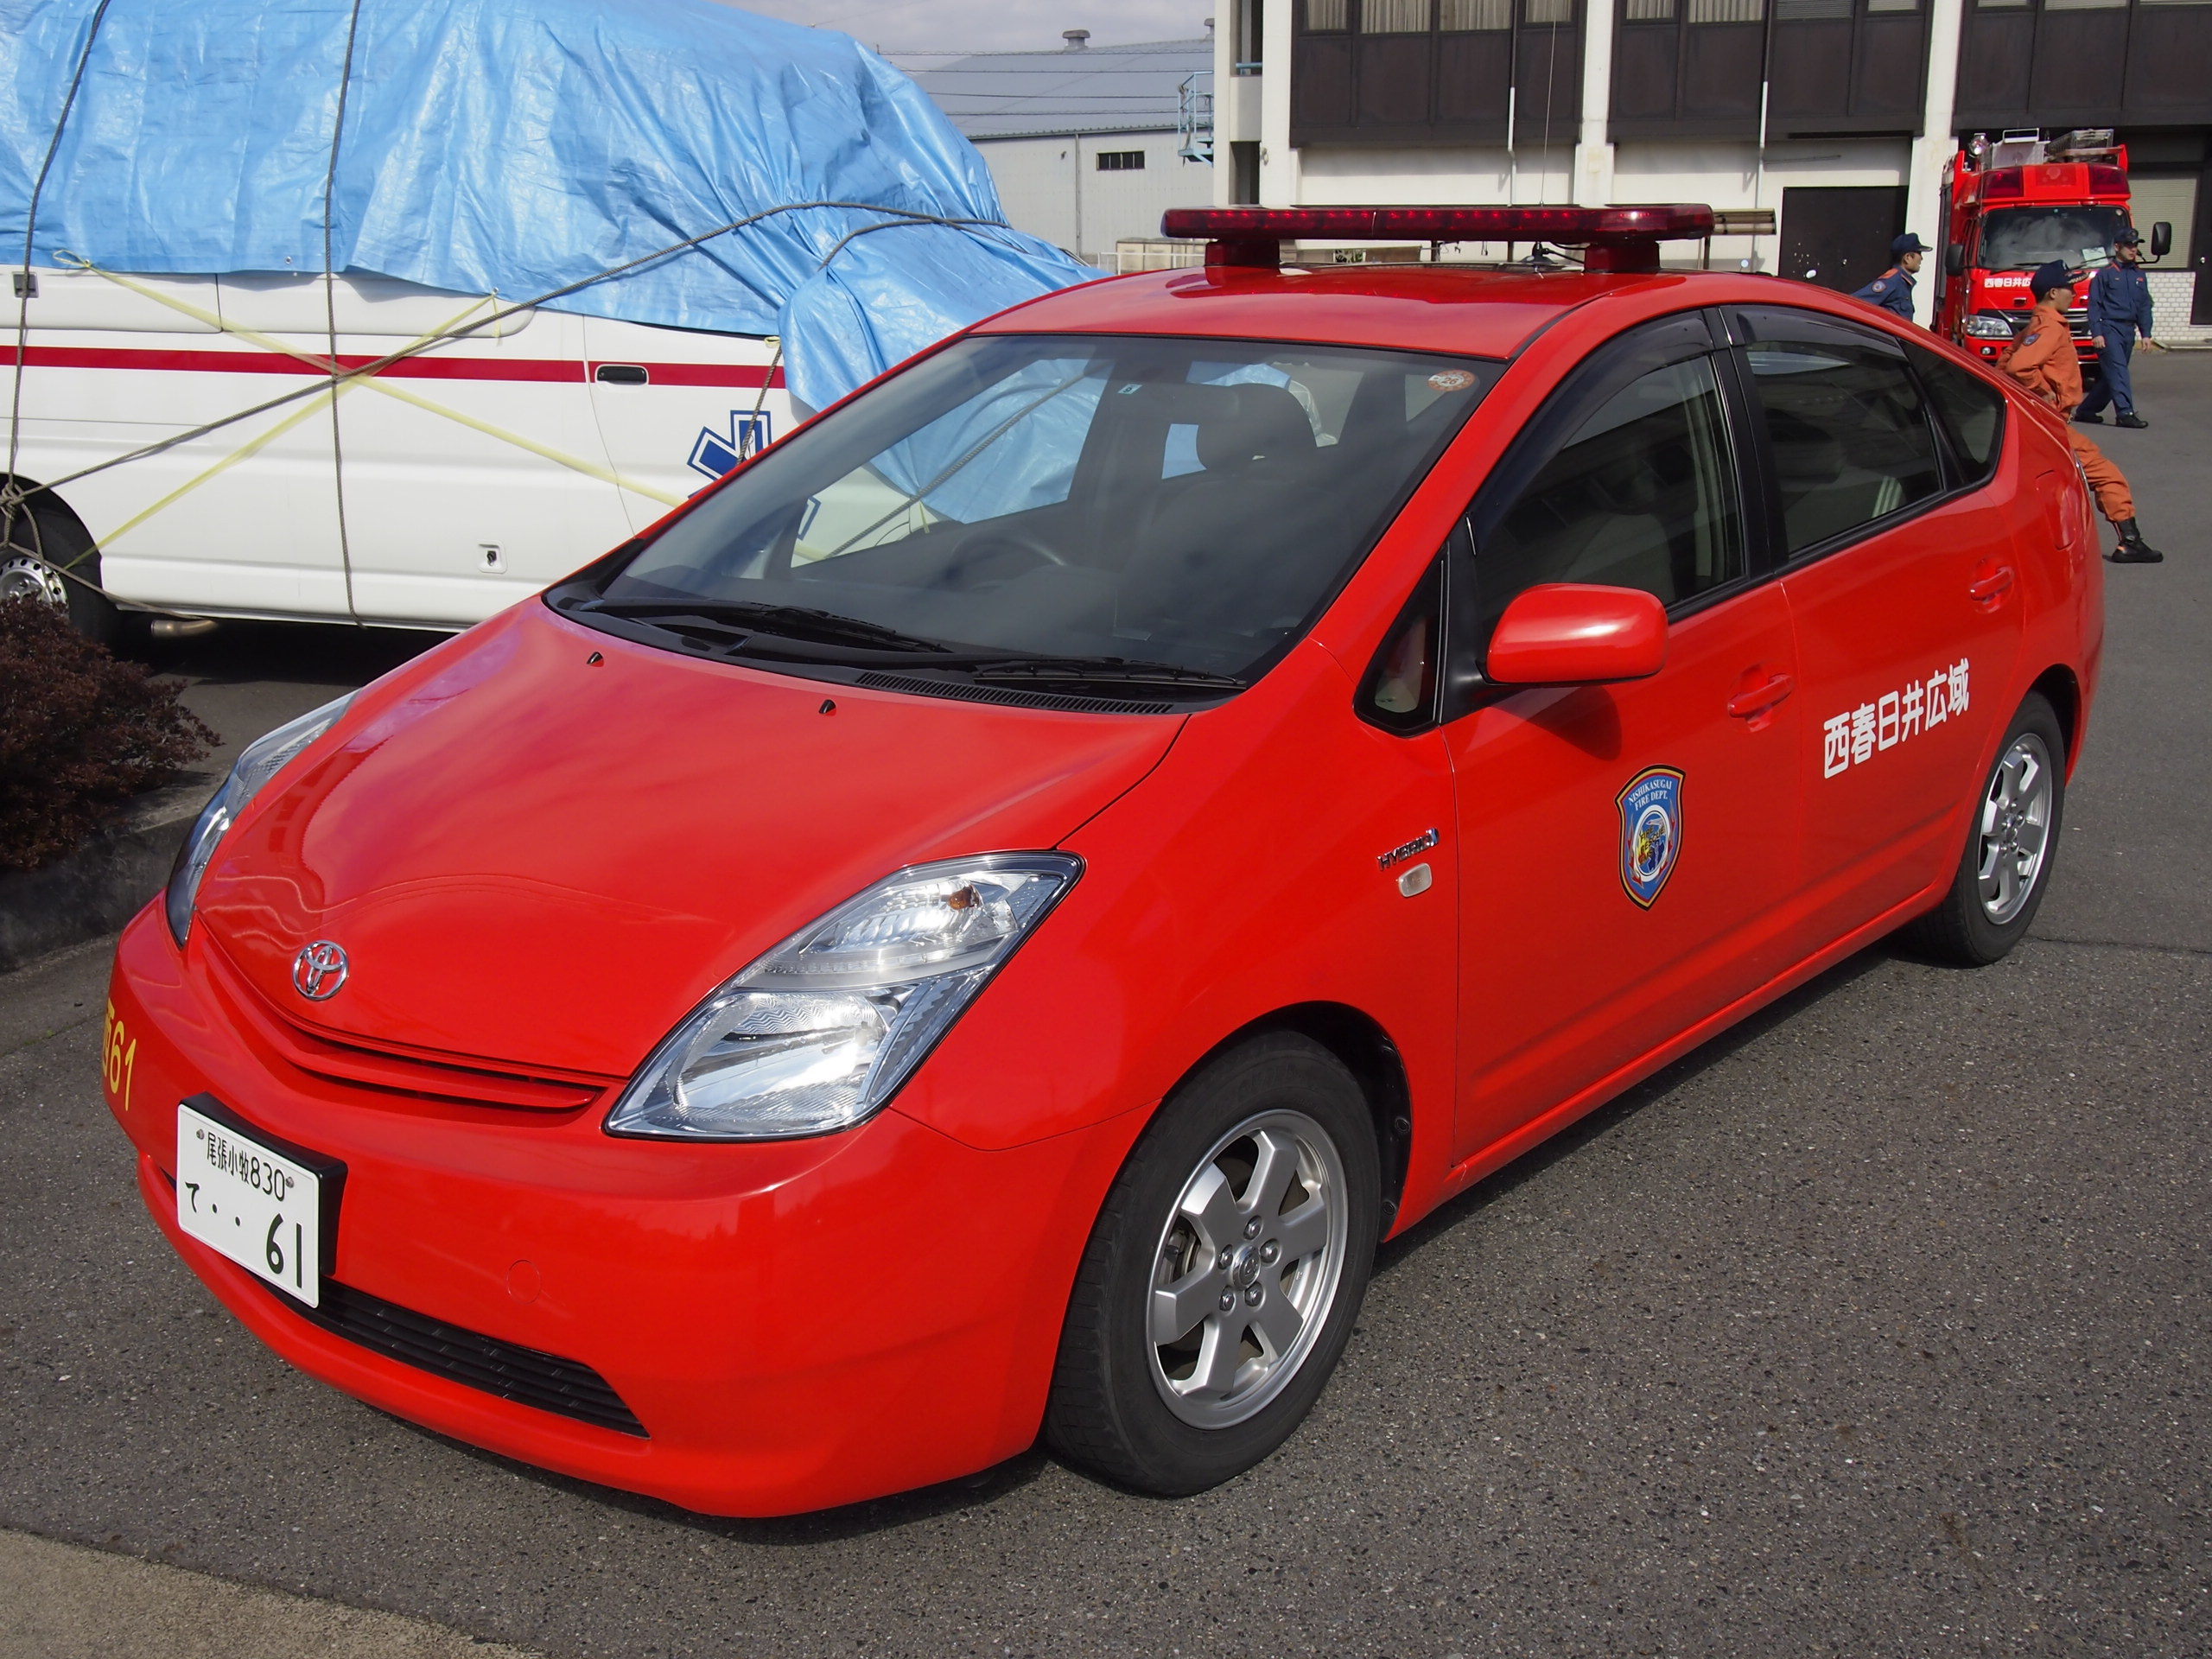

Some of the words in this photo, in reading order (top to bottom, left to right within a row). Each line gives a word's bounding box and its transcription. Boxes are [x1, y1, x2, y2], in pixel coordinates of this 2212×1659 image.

[1824, 658, 1969, 779] 西春日井広域
[1628, 779, 1673, 806] NISHIKASUGAI
[1635, 797, 1649, 810] FIRE
